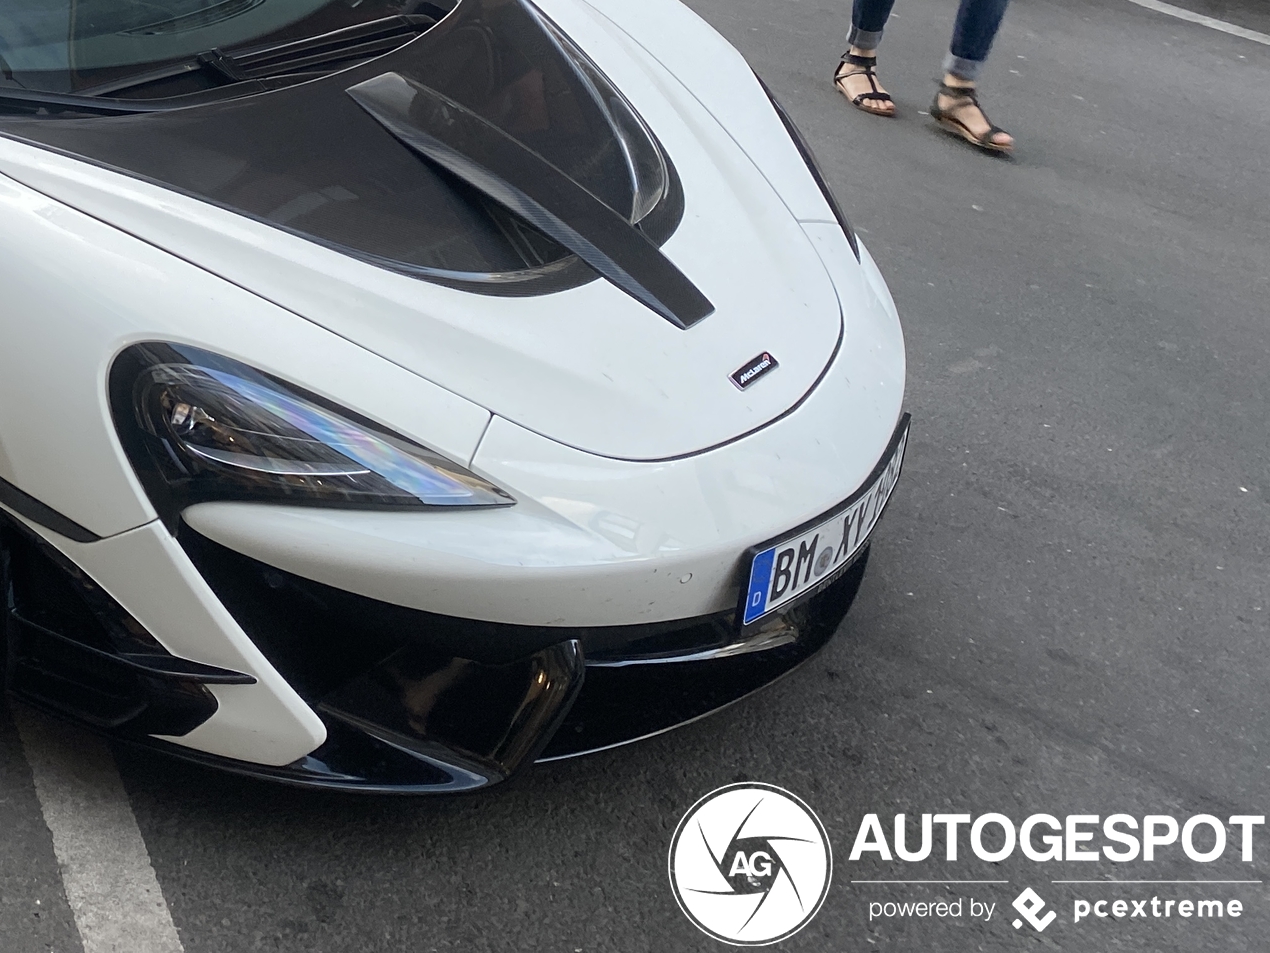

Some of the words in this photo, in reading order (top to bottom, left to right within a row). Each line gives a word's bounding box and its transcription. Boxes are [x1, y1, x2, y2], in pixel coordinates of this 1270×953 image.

[740, 359, 771, 384] McLaren
[769, 534, 819, 603] BM
[751, 591, 762, 607] D
